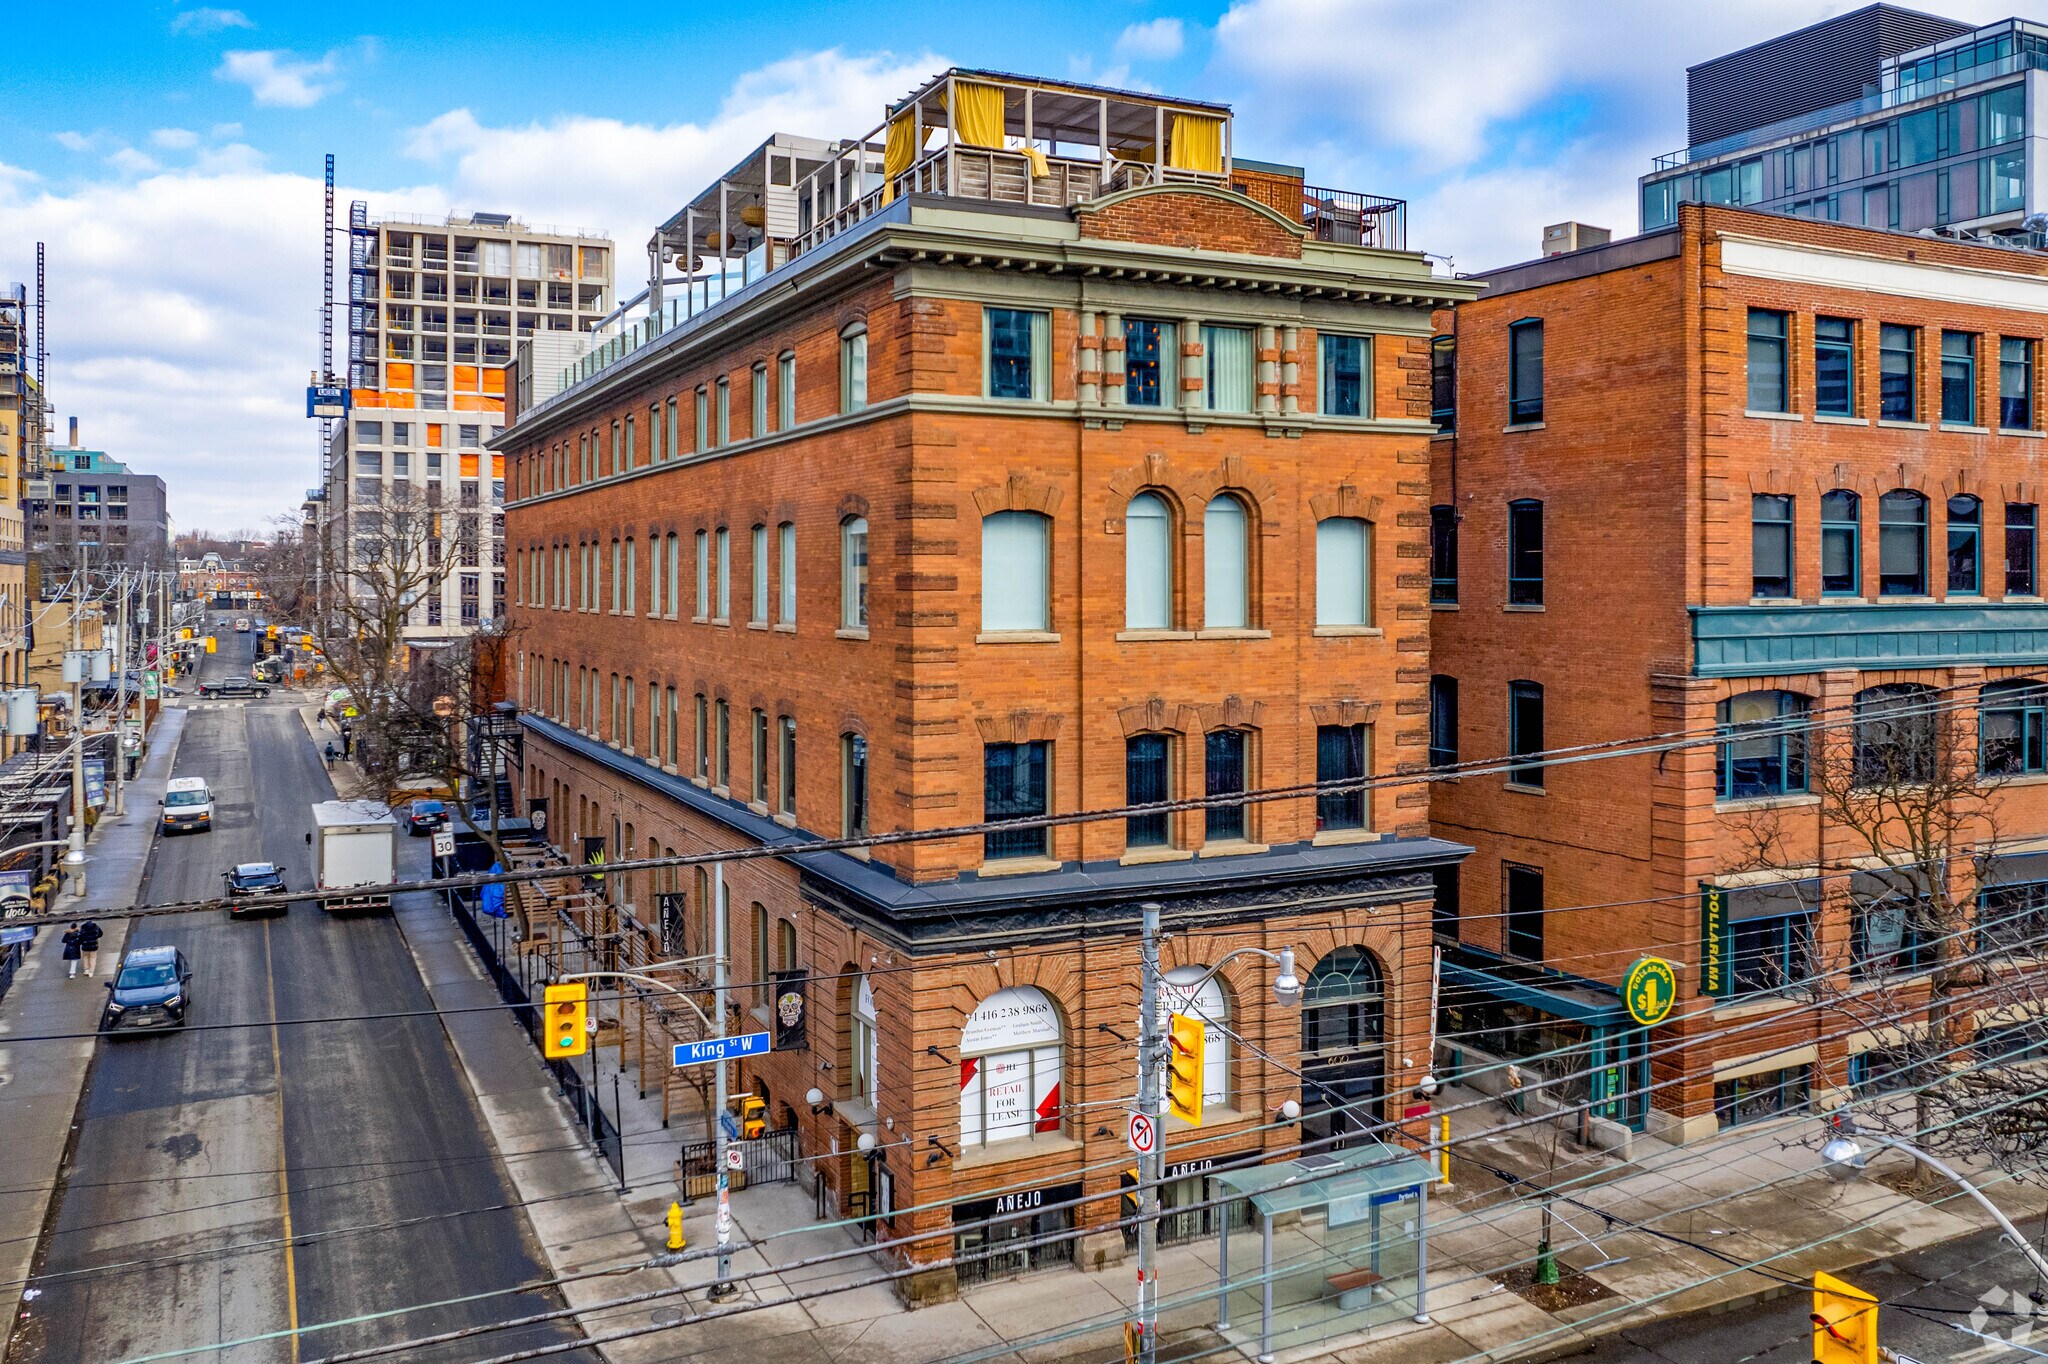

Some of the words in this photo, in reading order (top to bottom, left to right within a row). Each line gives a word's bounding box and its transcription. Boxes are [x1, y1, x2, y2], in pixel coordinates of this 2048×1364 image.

[437, 841, 452, 853] 30
[1709, 888, 1720, 991] DOLLARAMA
[1632, 965, 1670, 990] DOLLARAMA
[1173, 996, 1208, 1010] LESE
[980, 1009, 998, 1021] 416
[1001, 1006, 1020, 1018] 238
[1023, 1003, 1048, 1015] 9868
[691, 1043, 725, 1058] King
[729, 1039, 738, 1047] St
[741, 1036, 753, 1051] W
[989, 1084, 1024, 1097] RETAIL
[996, 1098, 1015, 1109] FOR
[992, 1109, 1023, 1122] LEASE
[996, 1190, 1041, 1214] AÑEJO
